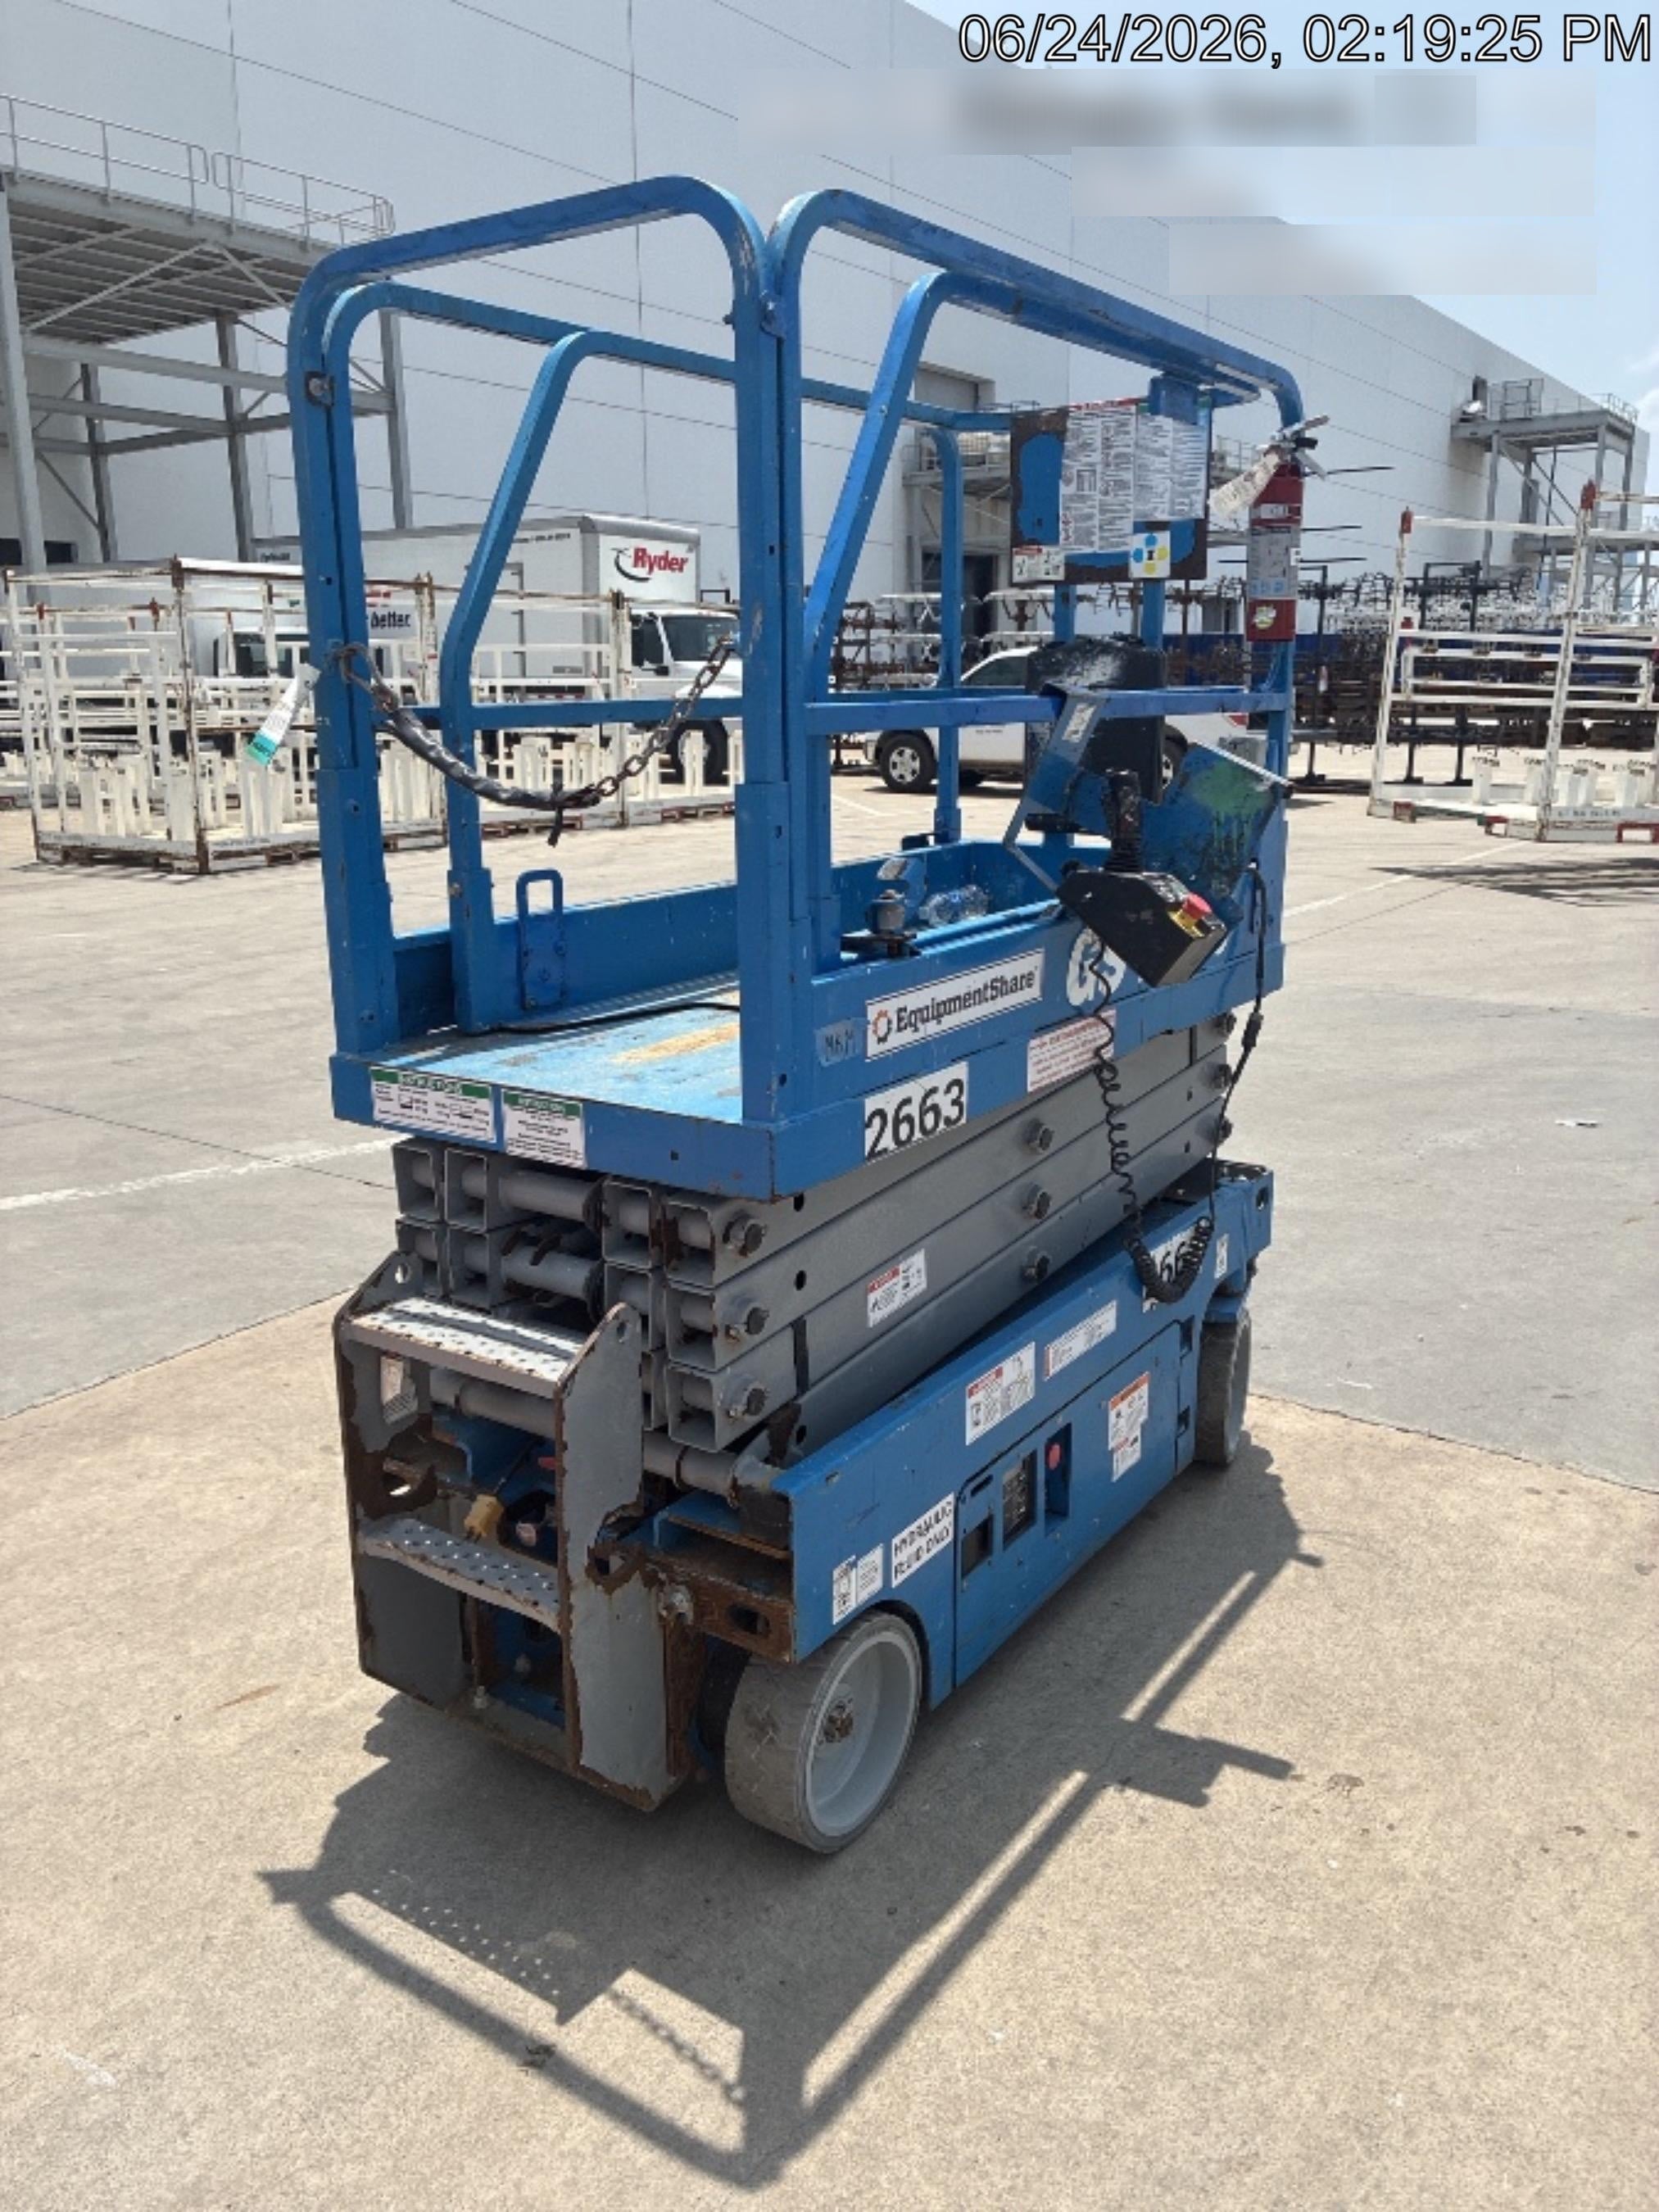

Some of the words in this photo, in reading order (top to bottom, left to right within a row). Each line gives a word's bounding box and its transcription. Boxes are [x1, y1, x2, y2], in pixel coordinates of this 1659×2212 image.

[632, 546, 688, 575] Ryder
[370, 611, 411, 629] better
[895, 969, 1036, 1033] EquipmentShare
[865, 1078, 964, 1161] 2663
